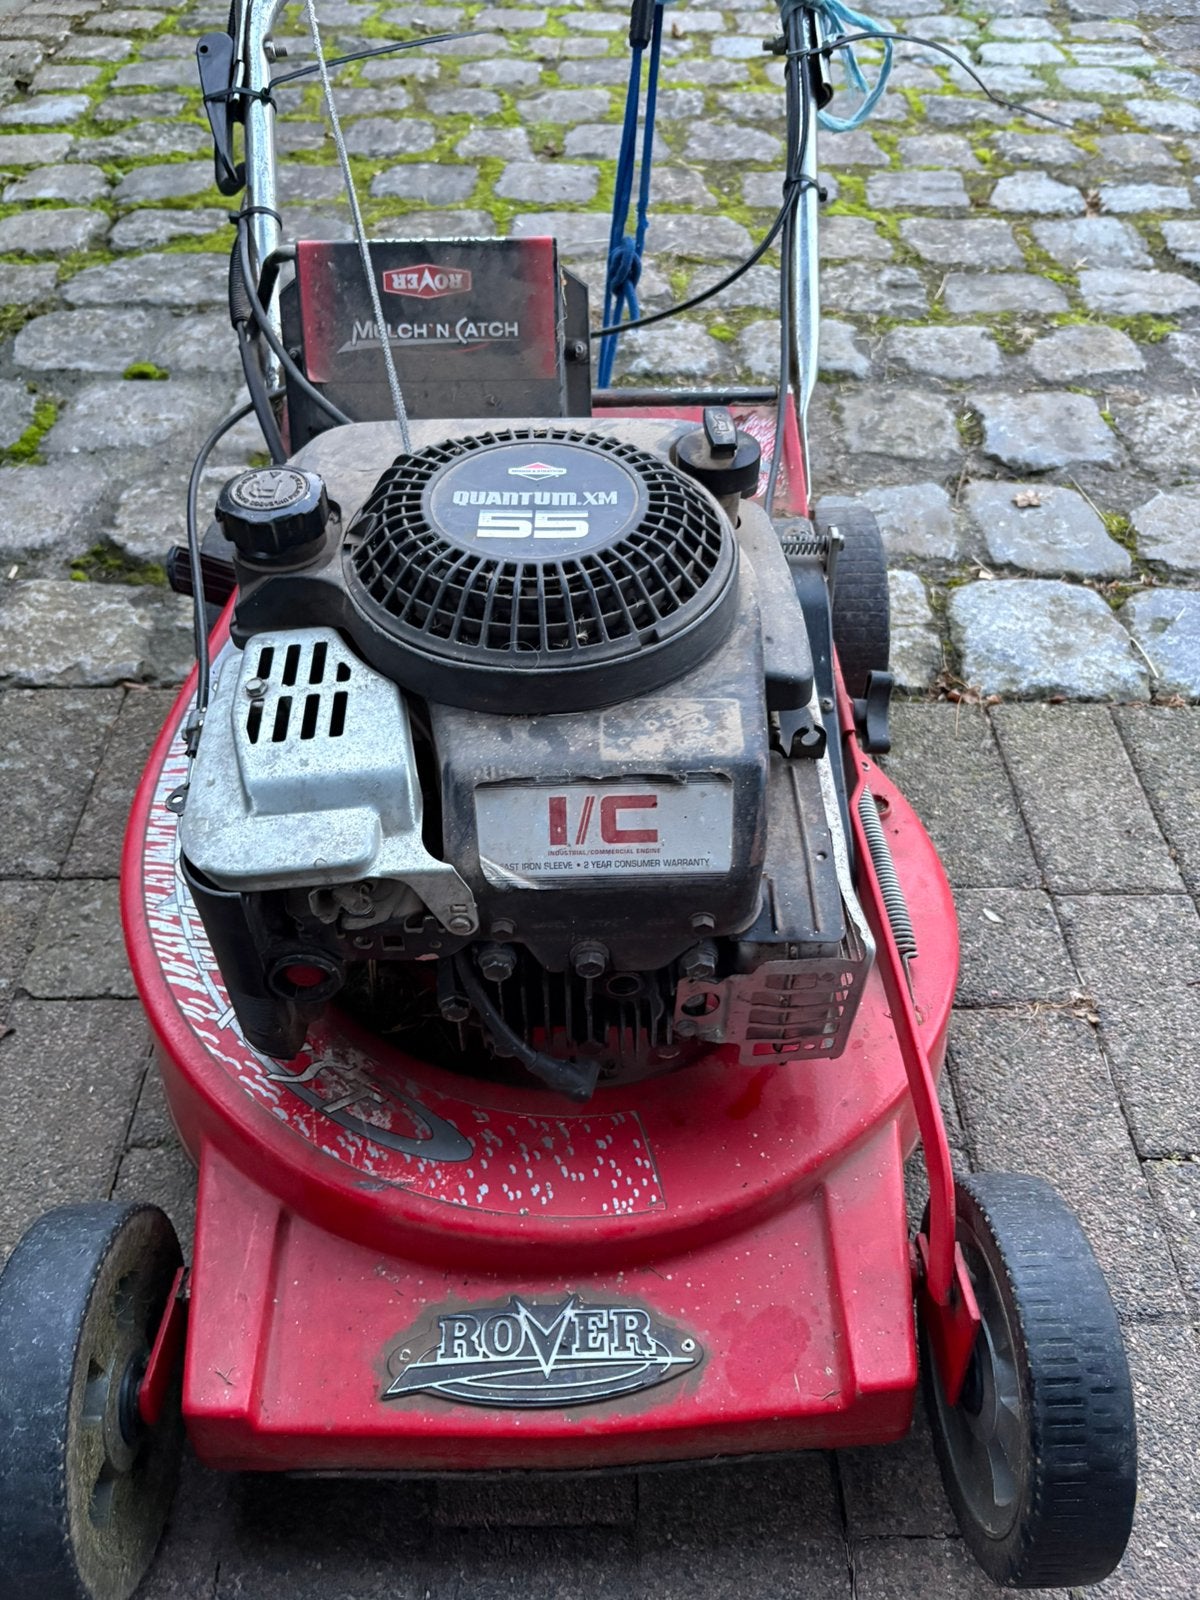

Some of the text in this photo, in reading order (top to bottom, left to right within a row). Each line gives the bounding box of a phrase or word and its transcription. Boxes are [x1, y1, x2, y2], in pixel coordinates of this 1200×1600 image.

[392, 268, 463, 293] ROVER
[455, 316, 519, 344] CATCH
[476, 509, 589, 539] 55
[548, 795, 658, 845] I/C
[522, 862, 541, 871] IRON
[543, 861, 573, 870] SLEEVE
[583, 861, 589, 869] 2
[591, 860, 612, 869] YEAR
[614, 859, 661, 868] CONSUMER
[663, 858, 710, 867] WARRANTY
[636, 847, 661, 855] ENGINE
[437, 1296, 657, 1379] ROVER
